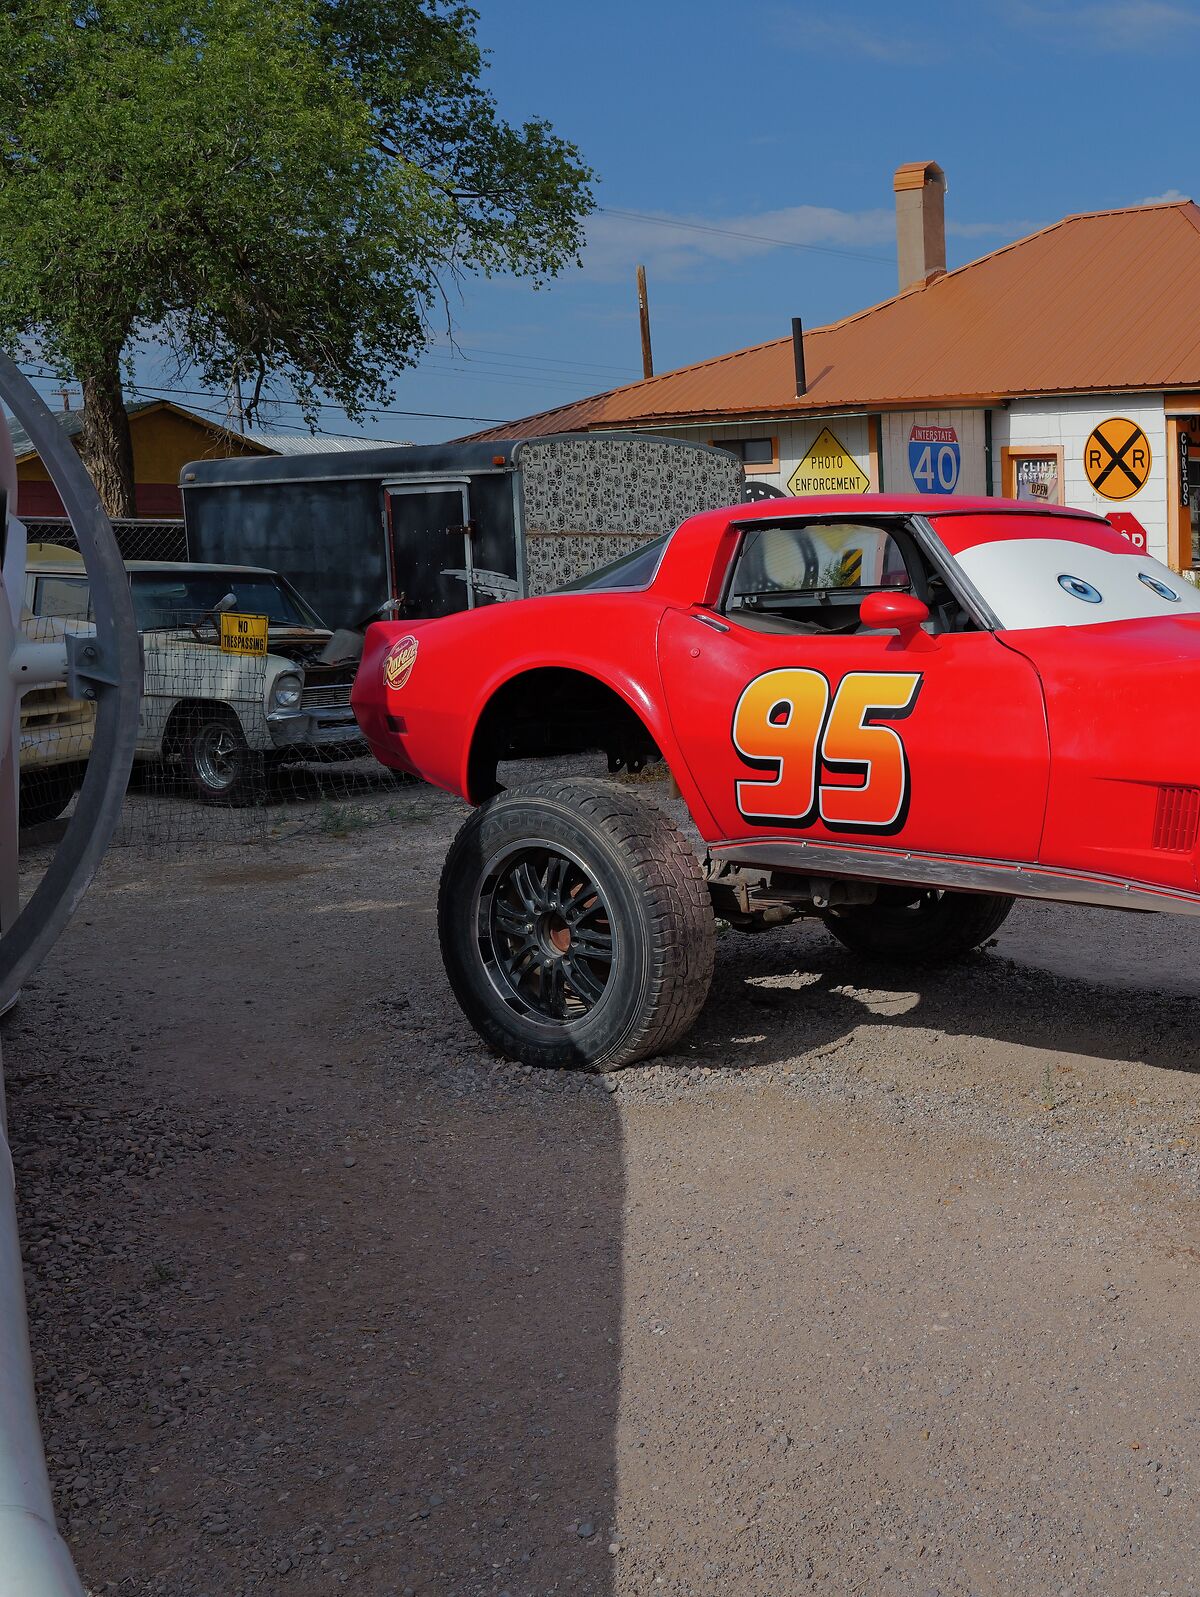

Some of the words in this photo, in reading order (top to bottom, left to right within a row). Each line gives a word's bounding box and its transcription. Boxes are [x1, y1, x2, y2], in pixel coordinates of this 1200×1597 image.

[915, 429, 953, 441] INTERSTATE
[811, 455, 843, 469] PHOTO
[913, 445, 957, 490] 40
[1022, 461, 1056, 472] CLINT
[1180, 432, 1190, 506] CURIOS
[795, 476, 861, 491] ENFORCEMENT
[1031, 483, 1048, 496] OPEN
[238, 620, 248, 633] NO
[223, 634, 265, 651] TRESPASSING
[730, 665, 925, 837] 95
